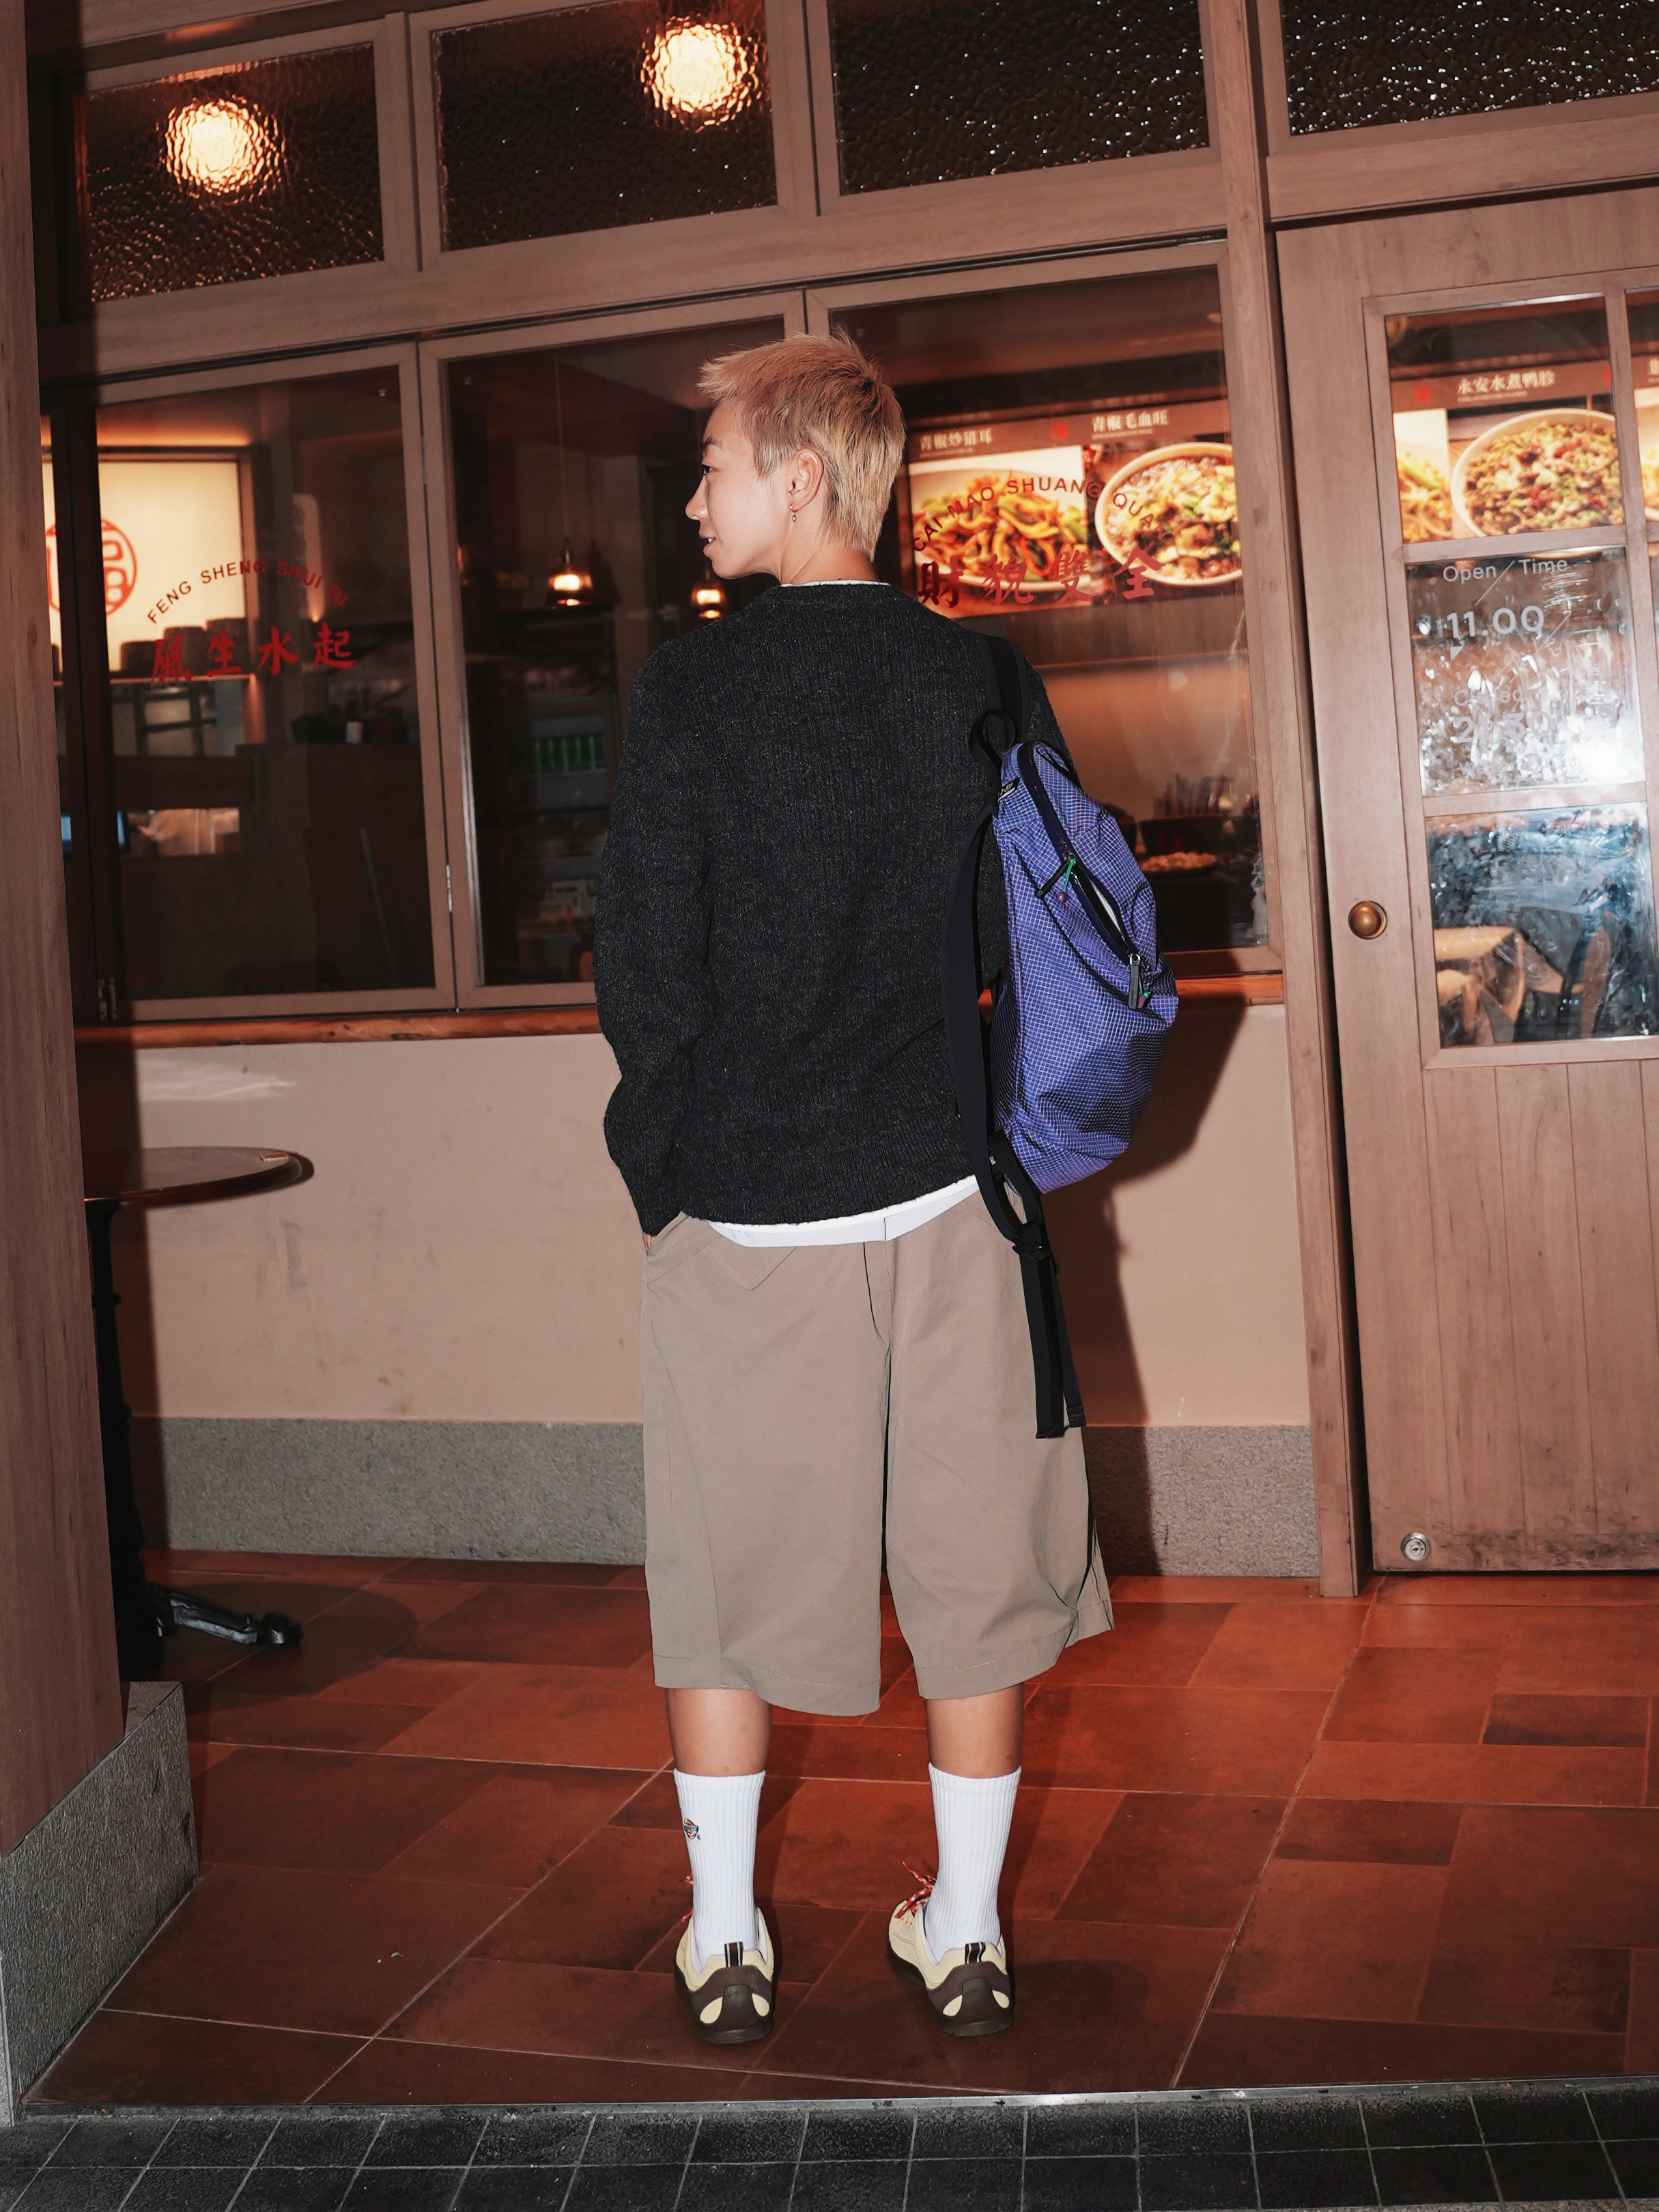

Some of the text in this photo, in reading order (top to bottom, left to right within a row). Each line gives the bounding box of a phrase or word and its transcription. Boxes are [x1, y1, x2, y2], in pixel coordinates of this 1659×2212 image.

[913, 516, 943, 552] CAI
[947, 486, 995, 519] MAO
[1007, 477, 1103, 498] SHUANG
[147, 559, 349, 623] FENG SHENG SHUI QI
[1443, 558, 1568, 584] Open Time
[1446, 606, 1544, 638] 11.00
[152, 623, 358, 682] 風生水起
